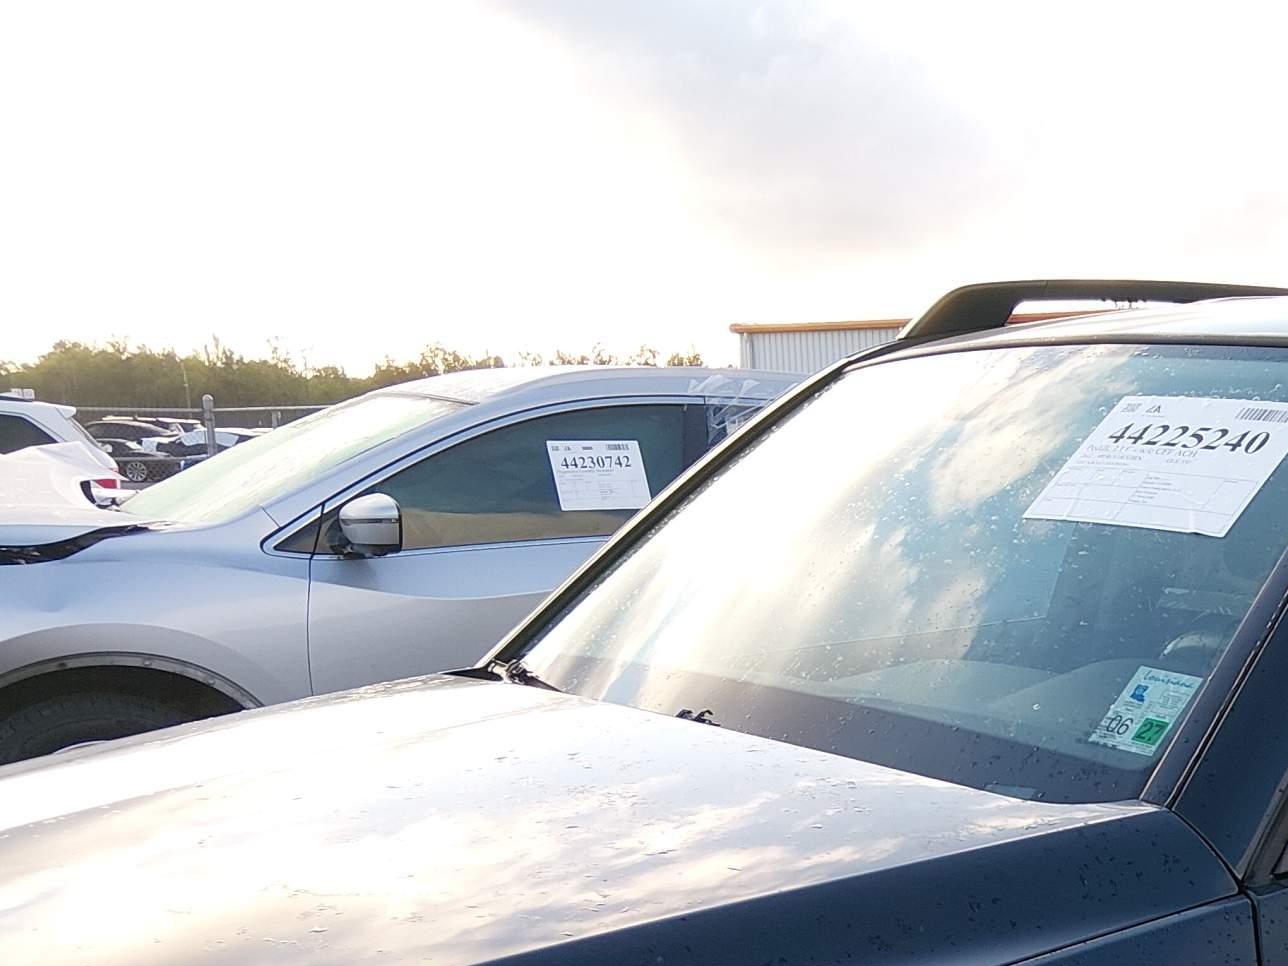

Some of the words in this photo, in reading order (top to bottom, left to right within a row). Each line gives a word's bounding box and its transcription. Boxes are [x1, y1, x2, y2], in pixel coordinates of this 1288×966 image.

[1108, 422, 1271, 455] 44225240
[560, 455, 631, 469] 44230742
[1106, 714, 1134, 735] 06
[1135, 720, 1164, 740] 27
